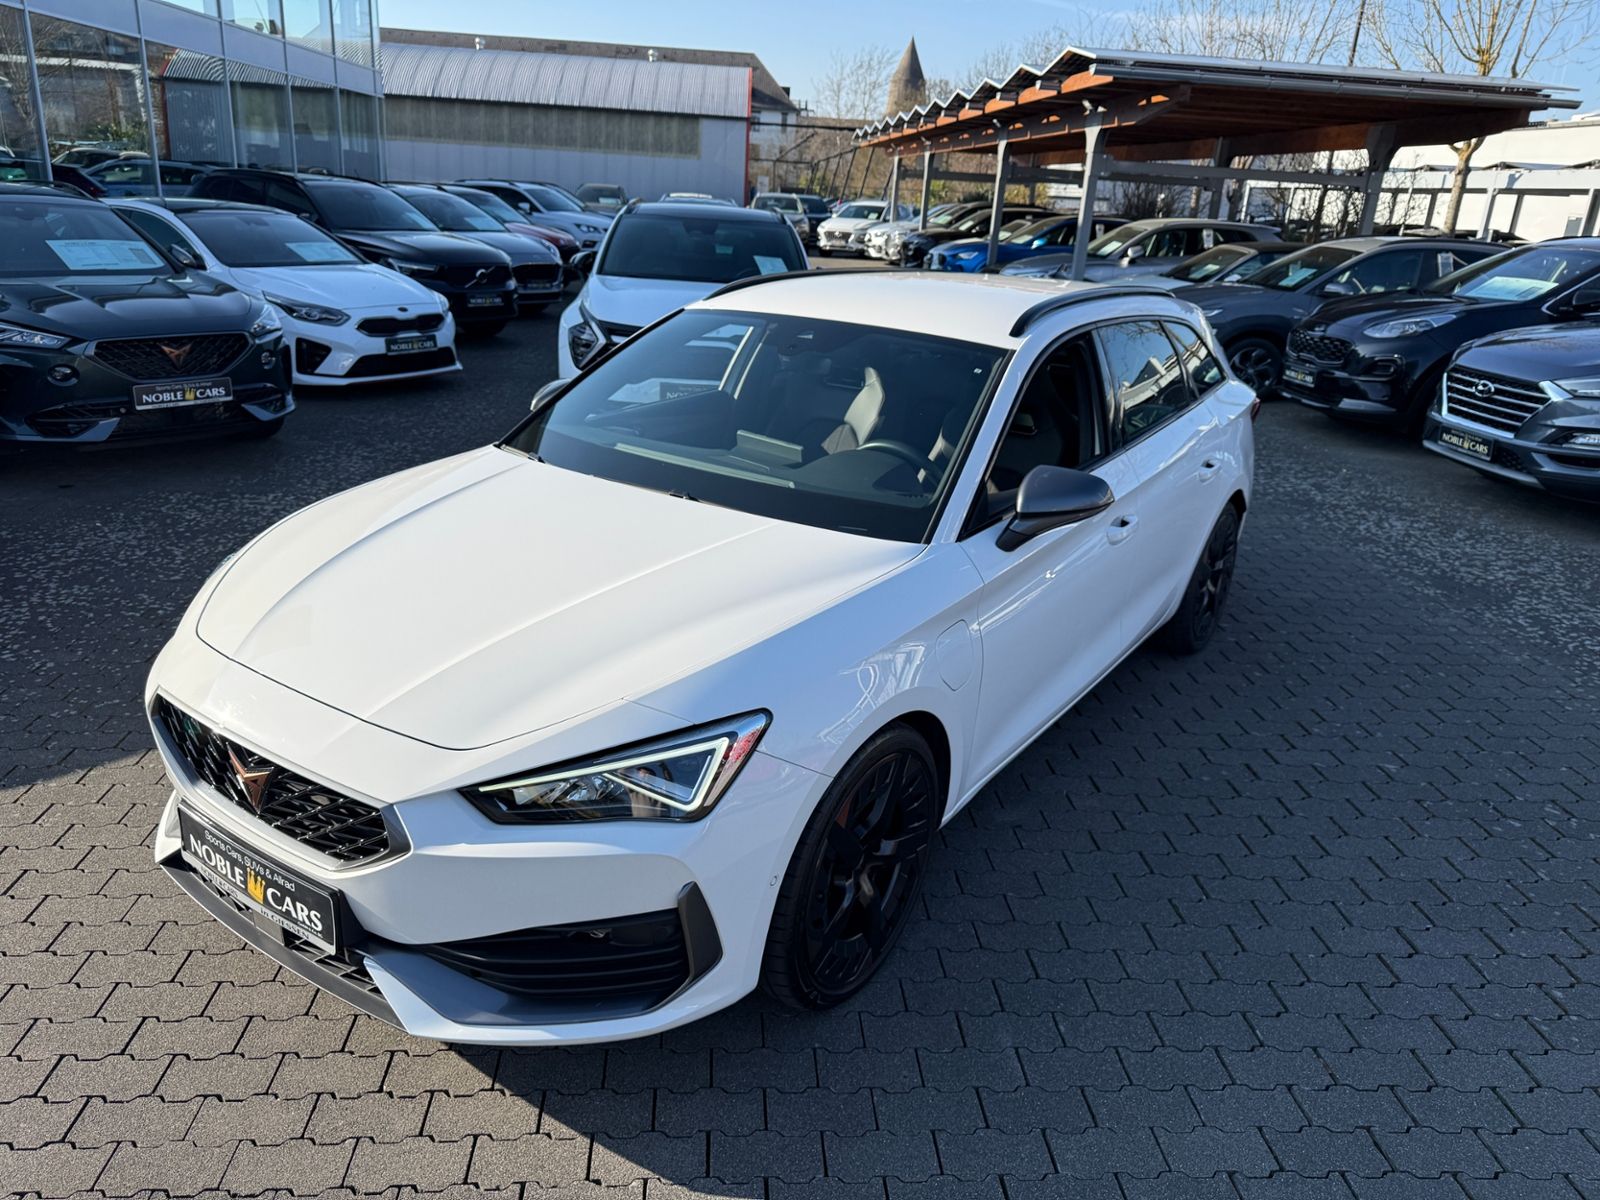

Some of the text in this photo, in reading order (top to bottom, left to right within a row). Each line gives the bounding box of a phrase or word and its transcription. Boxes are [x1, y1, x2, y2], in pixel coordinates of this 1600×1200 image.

[142, 390, 183, 403] NOBLE
[196, 386, 226, 398] CARS
[1442, 433, 1463, 446] NOBLE
[1470, 441, 1489, 454] CARS
[204, 829, 296, 892] Sports Cars, SUVs & Allrad
[189, 833, 323, 932] NOBLE CARS
